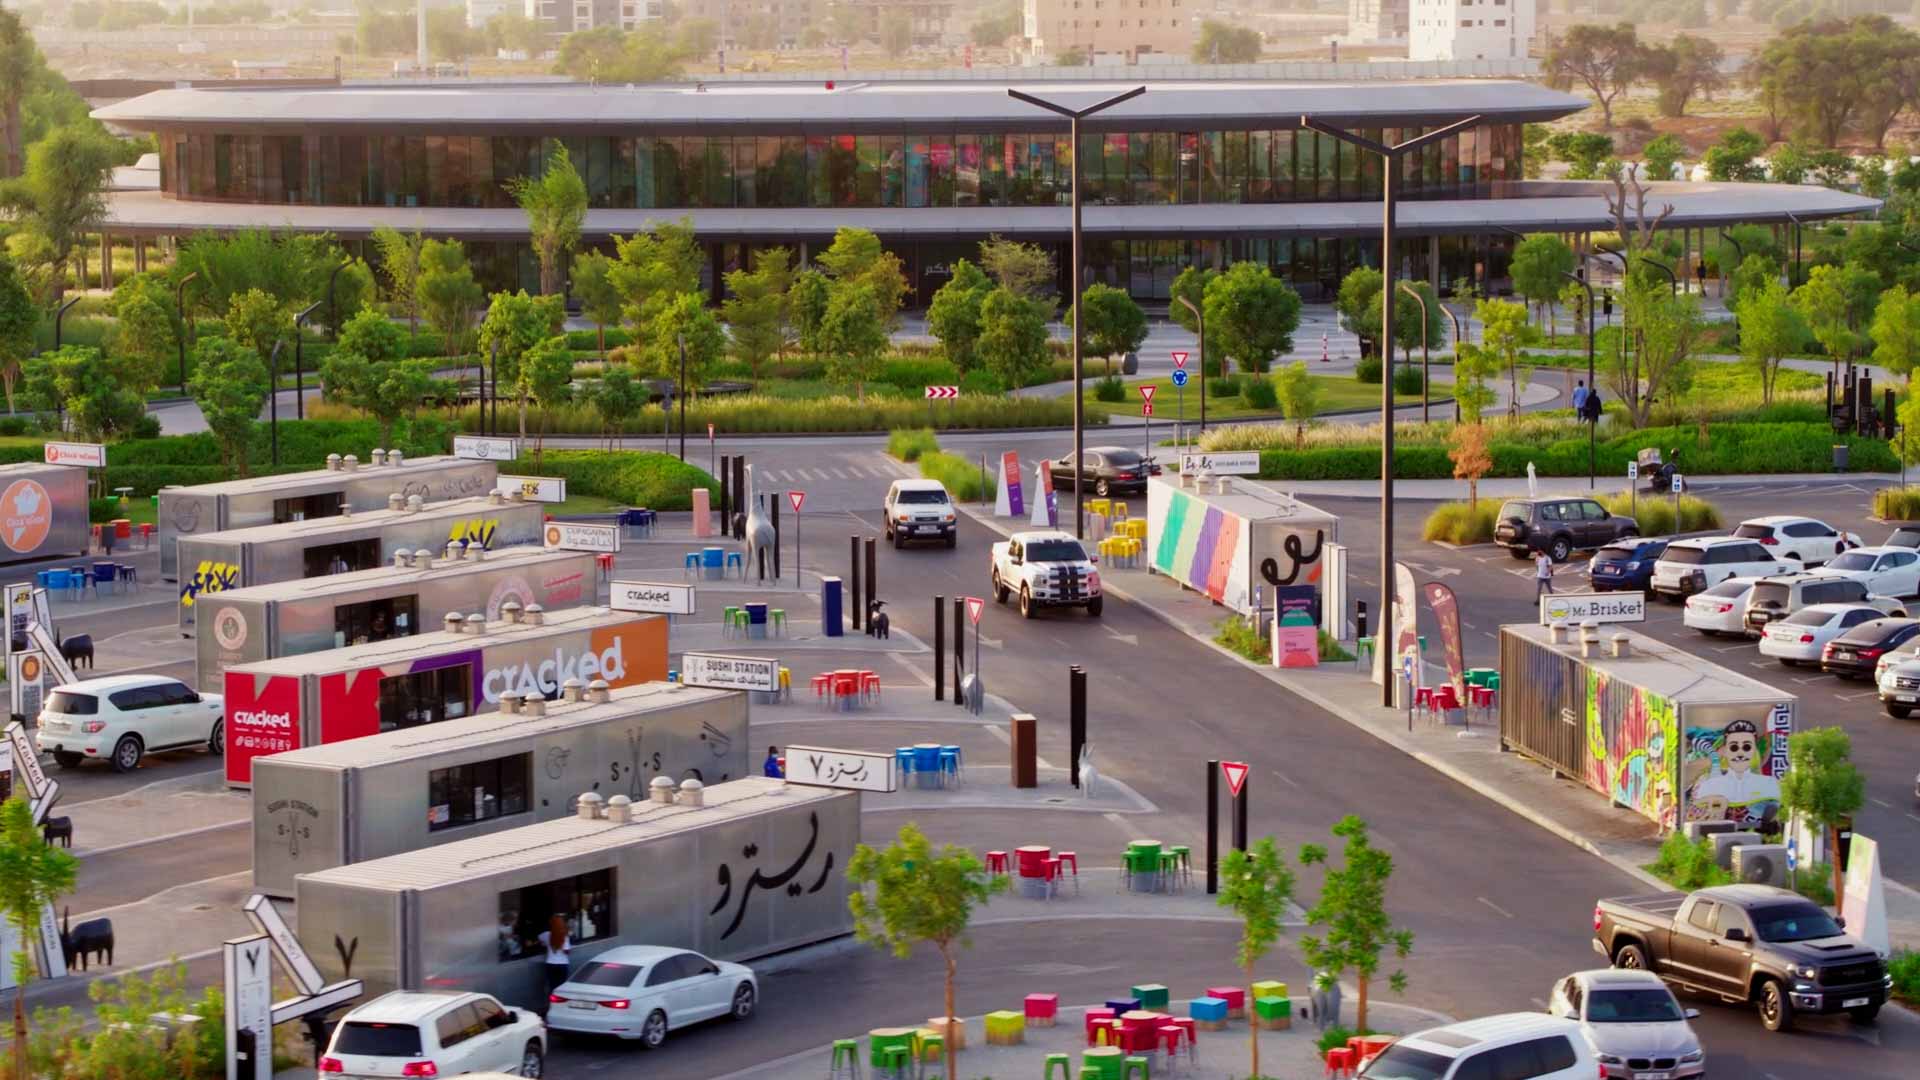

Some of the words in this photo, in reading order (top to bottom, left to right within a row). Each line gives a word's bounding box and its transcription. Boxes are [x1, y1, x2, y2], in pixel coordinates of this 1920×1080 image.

[1590, 601, 1642, 616] Brisket
[706, 660, 732, 672] SUSHI
[735, 662, 769, 675] STATION
